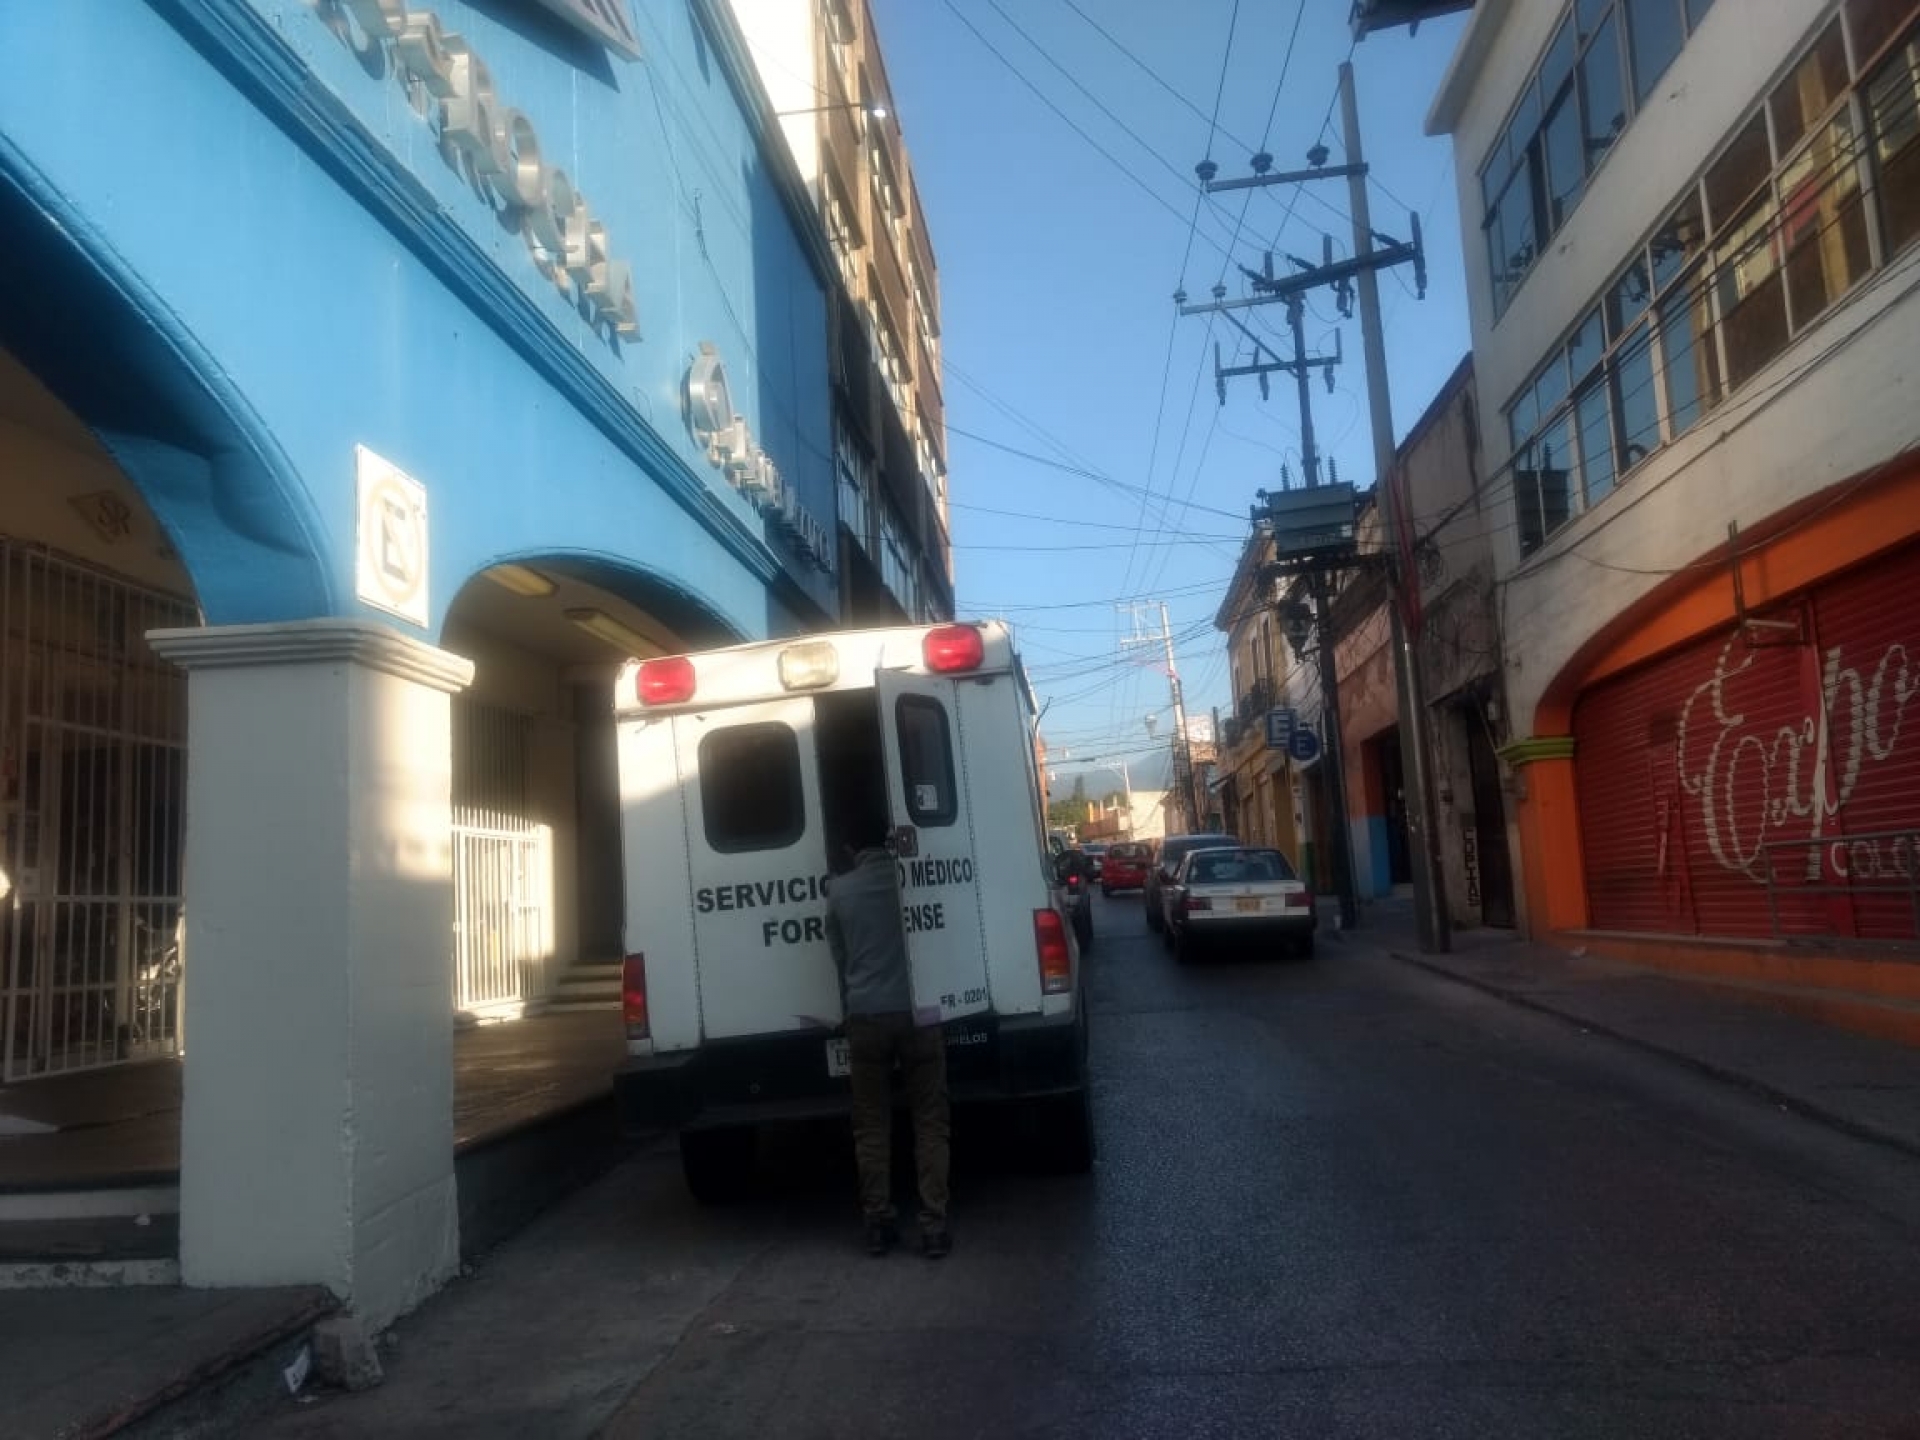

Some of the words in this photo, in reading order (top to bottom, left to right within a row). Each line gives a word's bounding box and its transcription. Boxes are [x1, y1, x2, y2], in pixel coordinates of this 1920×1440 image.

[1271, 714, 1289, 744] E
[1296, 737, 1310, 755] E
[910, 853, 973, 888] MÉDICO
